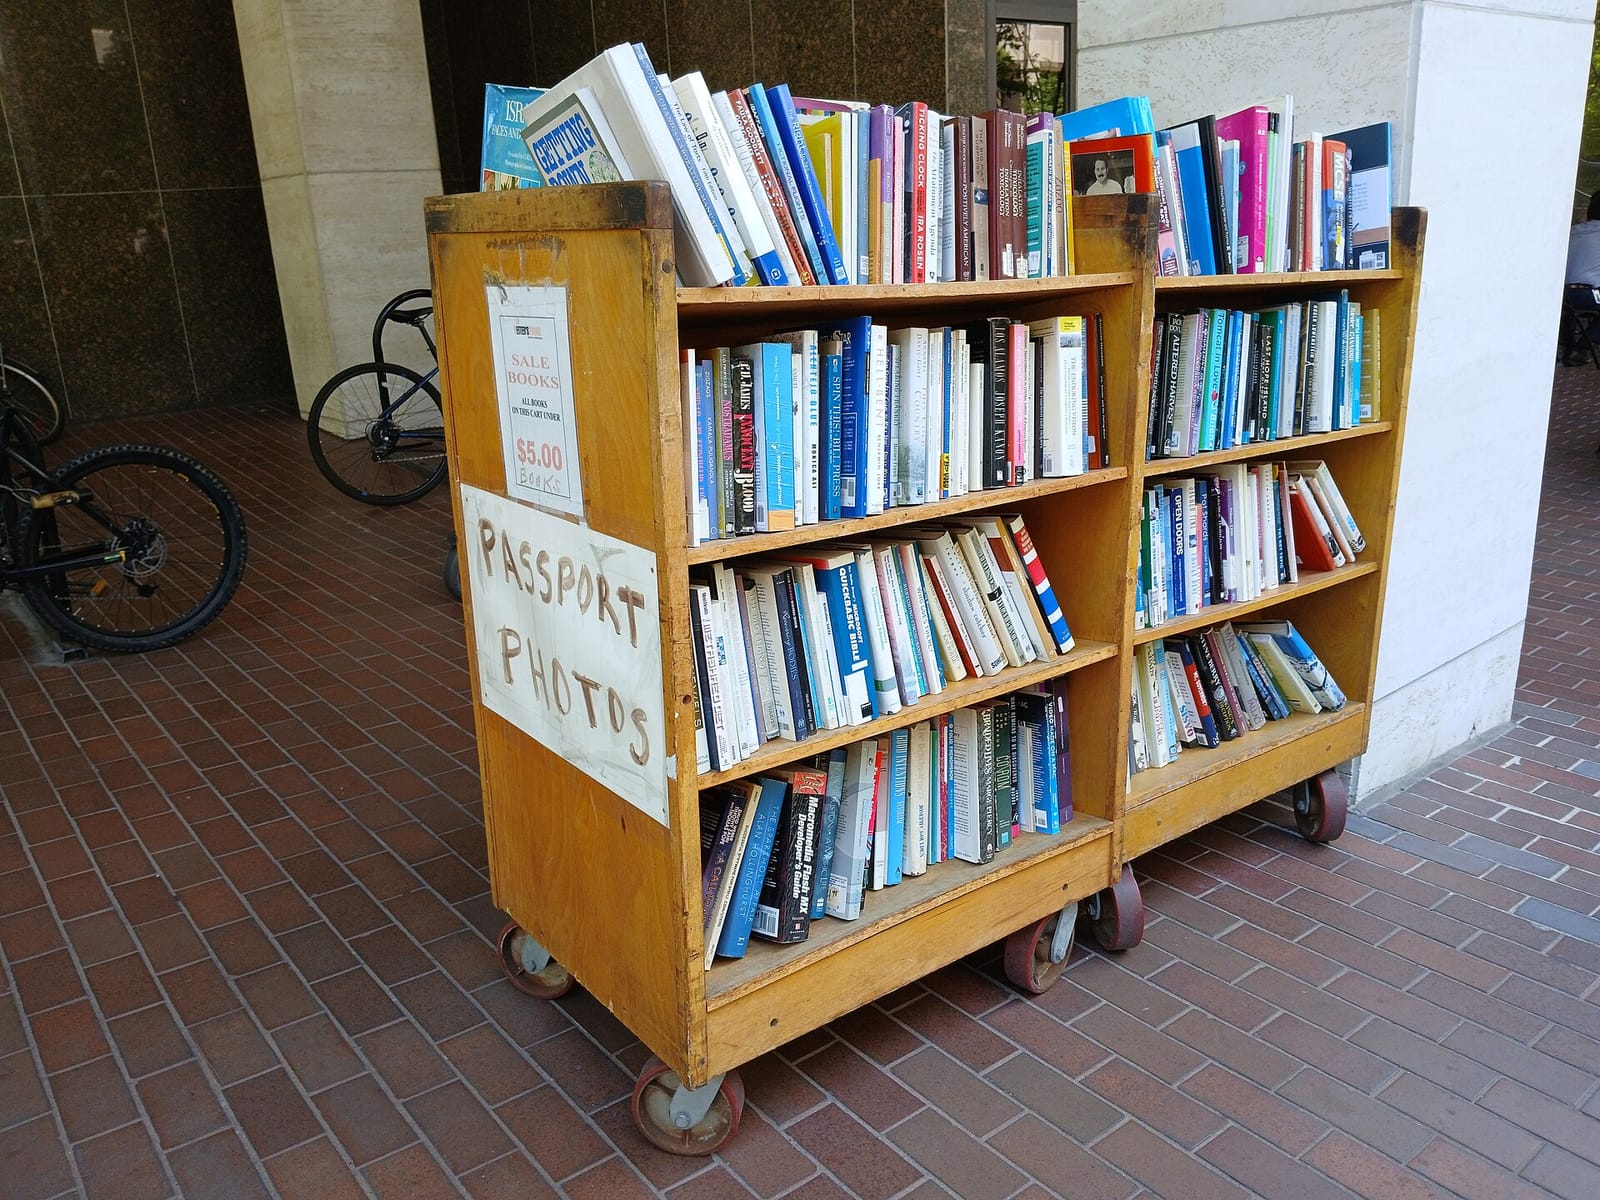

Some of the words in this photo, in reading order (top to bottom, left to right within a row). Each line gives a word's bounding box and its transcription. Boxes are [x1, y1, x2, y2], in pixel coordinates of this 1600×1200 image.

[532, 112, 596, 174] GETTING
[679, 118, 690, 133] Law
[686, 134, 694, 142] of
[735, 100, 748, 125] PAULA
[746, 126, 765, 166] GOODLETT
[791, 121, 807, 152] Right
[930, 168, 938, 218] Attainment
[1335, 154, 1344, 199] MCSE
[929, 223, 937, 256] Agenda
[994, 328, 1005, 343] LOS
[1215, 313, 1225, 350] Tomcat
[512, 354, 550, 370] SALE
[809, 345, 817, 395] ALENTEJO
[994, 346, 1006, 383] ALAMOS
[1171, 335, 1180, 379] ALTERED
[1214, 353, 1222, 362] in
[508, 371, 559, 389] BOOKS
[832, 376, 840, 403] SPIN
[1212, 366, 1221, 389] Love
[522, 398, 531, 406] ALL
[531, 398, 548, 408] BOOKS
[739, 382, 751, 410] JAMES
[994, 391, 1006, 425] JOSEPH
[1167, 381, 1176, 424] HARVEST
[512, 406, 520, 414] ON
[520, 408, 530, 416] THIS
[530, 409, 543, 418] CART
[544, 411, 560, 422] UNDER
[722, 400, 734, 461] NOSTRADAMUS
[832, 404, 841, 433] THIS!
[914, 390, 922, 441] COUNTRY
[516, 438, 562, 471] $5.00
[734, 413, 755, 470] INNOCENT
[832, 438, 840, 462] BILL
[994, 430, 1005, 460] KANON
[733, 467, 756, 513] BLOOD
[832, 466, 840, 497] PRESS
[478, 518, 645, 648] PASSPORT
[915, 586, 925, 604] WHO
[977, 553, 997, 590] FRIENDS
[995, 598, 1010, 621] HIGH
[1004, 619, 1021, 647] PLACES
[837, 567, 857, 631] QUICKBASIC
[848, 633, 861, 662] BIBLE
[851, 603, 864, 644] MICROSOFT
[961, 585, 977, 612] shadow
[972, 612, 989, 639] catcher
[1223, 628, 1237, 652] MAN
[786, 647, 798, 681] BODIES
[1197, 634, 1212, 660] STEVE
[1206, 659, 1222, 687] BERRY
[498, 624, 649, 766] PHOTOS
[1246, 698, 1262, 726] FALLACI
[981, 709, 993, 751] BRAIDED
[1179, 704, 1194, 738] OASIS
[1218, 701, 1233, 732] DECEPTION
[984, 752, 992, 774] LIVES
[1050, 745, 1056, 756] ON
[894, 755, 907, 797] INTENTIONS
[754, 813, 767, 839] ALAN
[769, 806, 780, 824] THE
[803, 797, 819, 862] Macromedia
[755, 827, 775, 885] SPARSHOLT
[793, 814, 808, 870] Developer's
[708, 866, 722, 892] CALL
[737, 843, 761, 919] HOLLINGHURST
[792, 871, 803, 899] Guide
[747, 888, 761, 923] AFFAIR
[799, 896, 809, 914] MX
